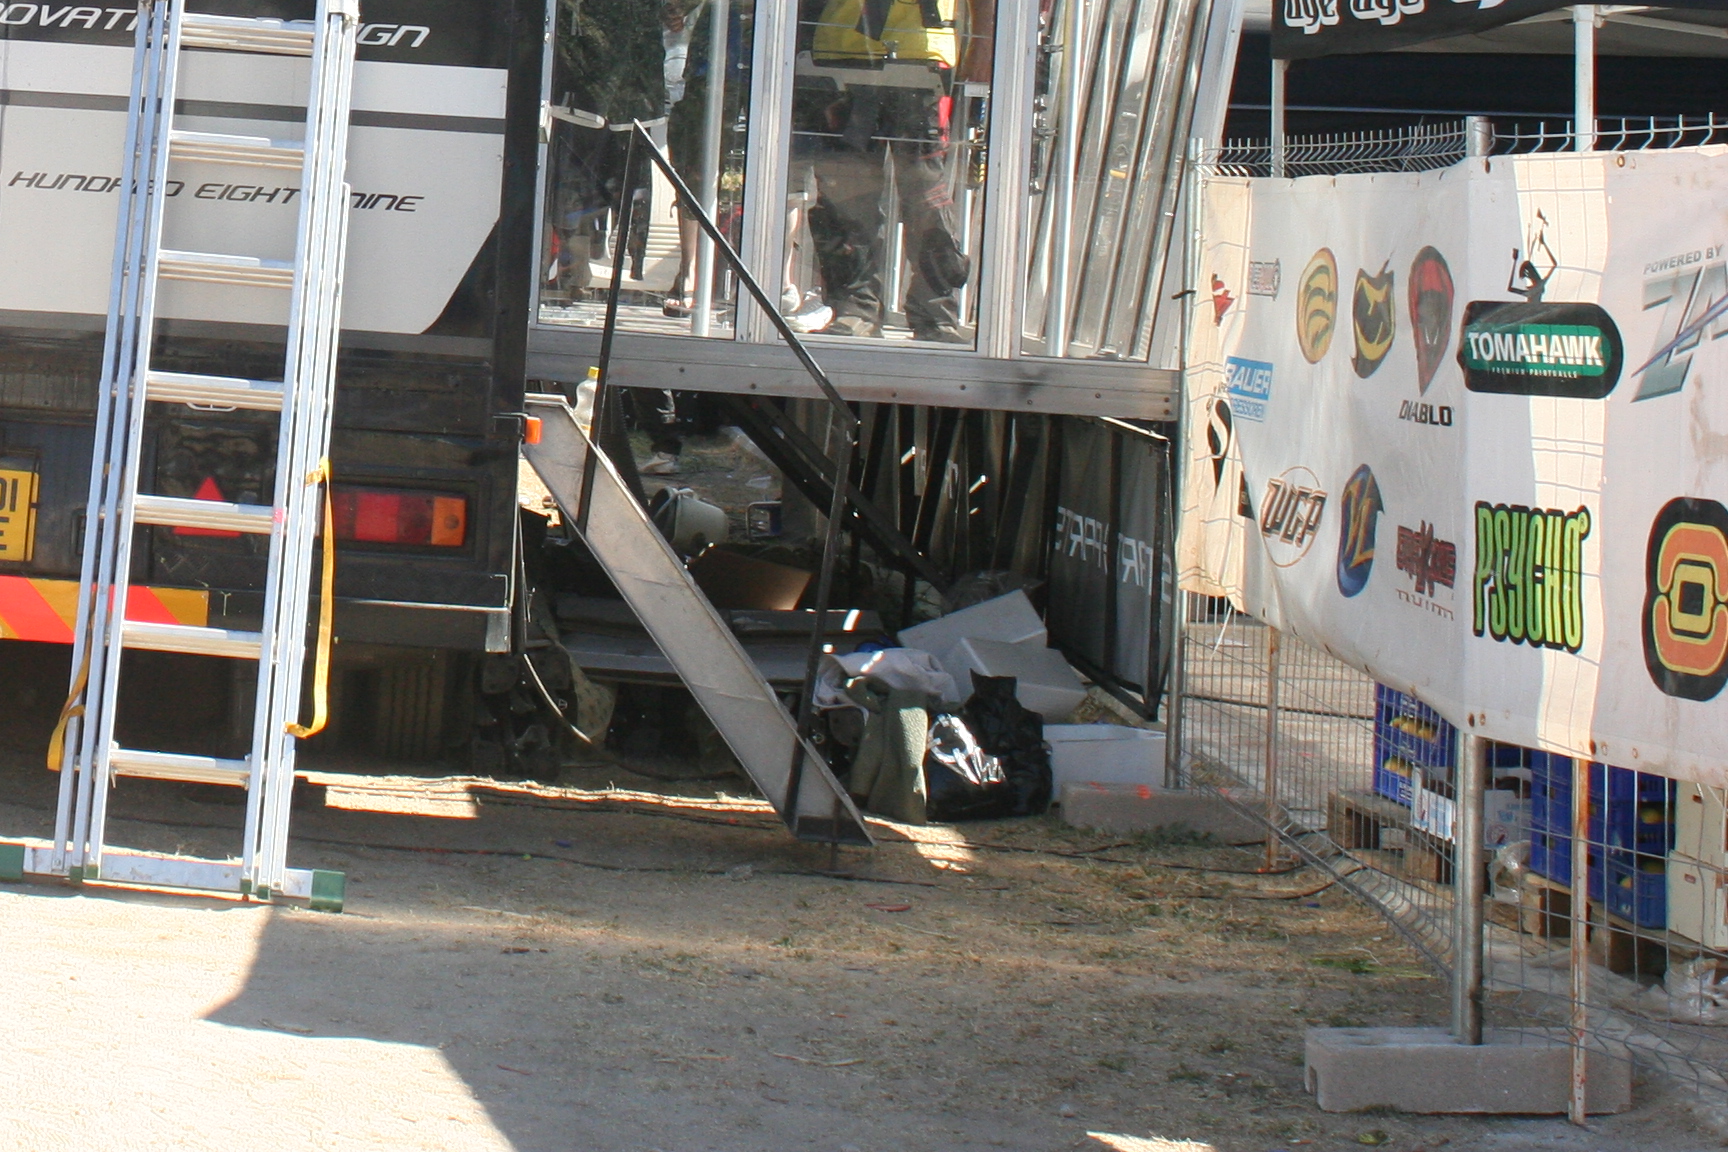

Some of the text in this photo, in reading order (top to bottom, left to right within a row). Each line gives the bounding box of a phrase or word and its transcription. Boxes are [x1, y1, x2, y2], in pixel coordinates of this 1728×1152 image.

[1643, 244, 1724, 276] POWERED BY
[1468, 331, 1605, 367] TOMAHAWK
[1398, 399, 1453, 427] DIABLO
[1473, 501, 1584, 655] PSYCHO
